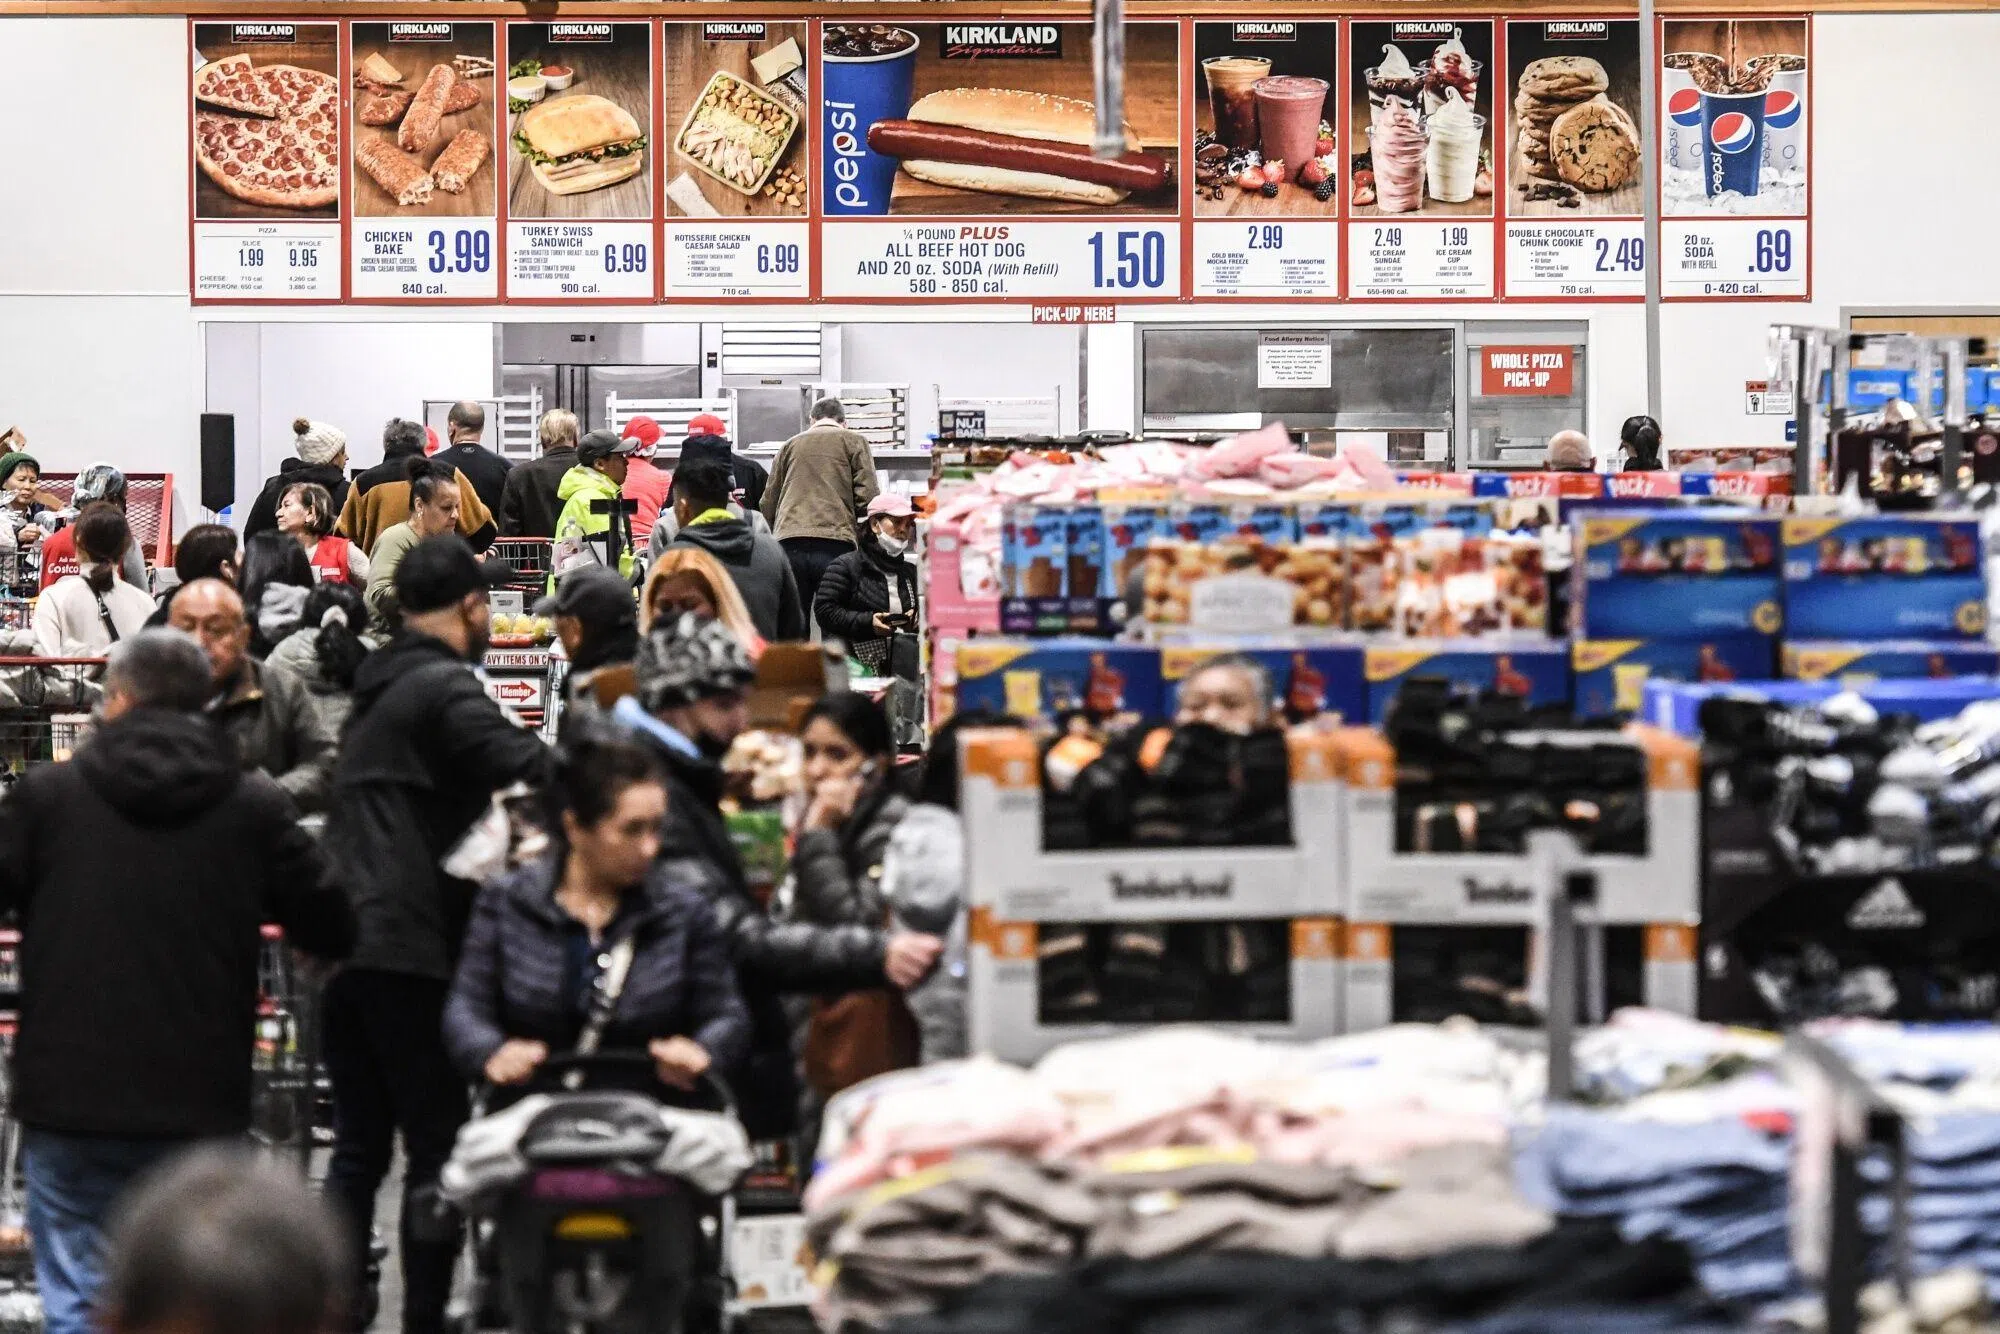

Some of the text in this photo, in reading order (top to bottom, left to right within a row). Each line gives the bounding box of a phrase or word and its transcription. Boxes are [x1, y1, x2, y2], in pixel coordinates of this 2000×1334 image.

[236, 25, 294, 35] KIRKLAND
[392, 24, 450, 34] KIRKLAND
[552, 24, 610, 35] KIRKLAND
[706, 24, 764, 34] KIRKLAND
[1236, 24, 1294, 33] KIRKLAND
[1395, 23, 1453, 33] KIRKLAND
[1547, 22, 1606, 32] KIRKLAND
[946, 26, 1058, 44] KIRKLAND
[946, 44, 1057, 64] Signature
[825, 99, 868, 207] pepsi
[365, 231, 413, 242] CHICKEN
[521, 226, 593, 236] TURKEY SWISS
[917, 229, 955, 240] POUND
[960, 226, 1009, 240] PLUS
[1508, 229, 1594, 238] DOUBLE CHOCOLATE
[531, 238, 583, 247] SANDWICH
[674, 234, 751, 242] ROTISSERIE CHICKEN
[1248, 225, 1283, 249] 2.99
[1375, 228, 1402, 246] 2.49
[1441, 228, 1468, 246] 1.99
[1684, 235, 1714, 245] 20 oz.
[374, 244, 403, 255] BAKE
[428, 230, 490, 273] 3.99
[685, 242, 740, 250] CAESAR SALAD
[885, 243, 1025, 257] ALL BEEF HOT DOG
[1748, 229, 1791, 272] .69
[238, 248, 264, 266] 1.99
[289, 248, 317, 266] 9.95
[1595, 238, 1644, 272] 2.49
[1685, 247, 1714, 257] SODA
[604, 244, 647, 273] 6.99
[758, 244, 799, 273] 6.99
[1087, 231, 1164, 288] 1.50
[857, 261, 1059, 278] AND 20 oz. SODA (With Refill)
[1681, 260, 1717, 269] WITH REFILL
[402, 283, 447, 294] 840 cal.
[561, 283, 600, 293] 900 cal.
[909, 279, 936, 293] 580
[952, 279, 978, 293] 850
[983, 279, 1008, 293] cal.
[1560, 286, 1595, 294] 750 cal.
[1742, 283, 1762, 294] cal.
[1034, 307, 1114, 321] PICK-UP HERE
[1490, 354, 1563, 369] WHOLE PIZZA
[1503, 372, 1550, 387] PICK-UP
[956, 418, 984, 428] NUT
[956, 429, 984, 438] BARS
[47, 563, 79, 574] Costco
[504, 655, 527, 664] ITEMS
[529, 655, 539, 664] ON
[502, 687, 531, 697] Member
